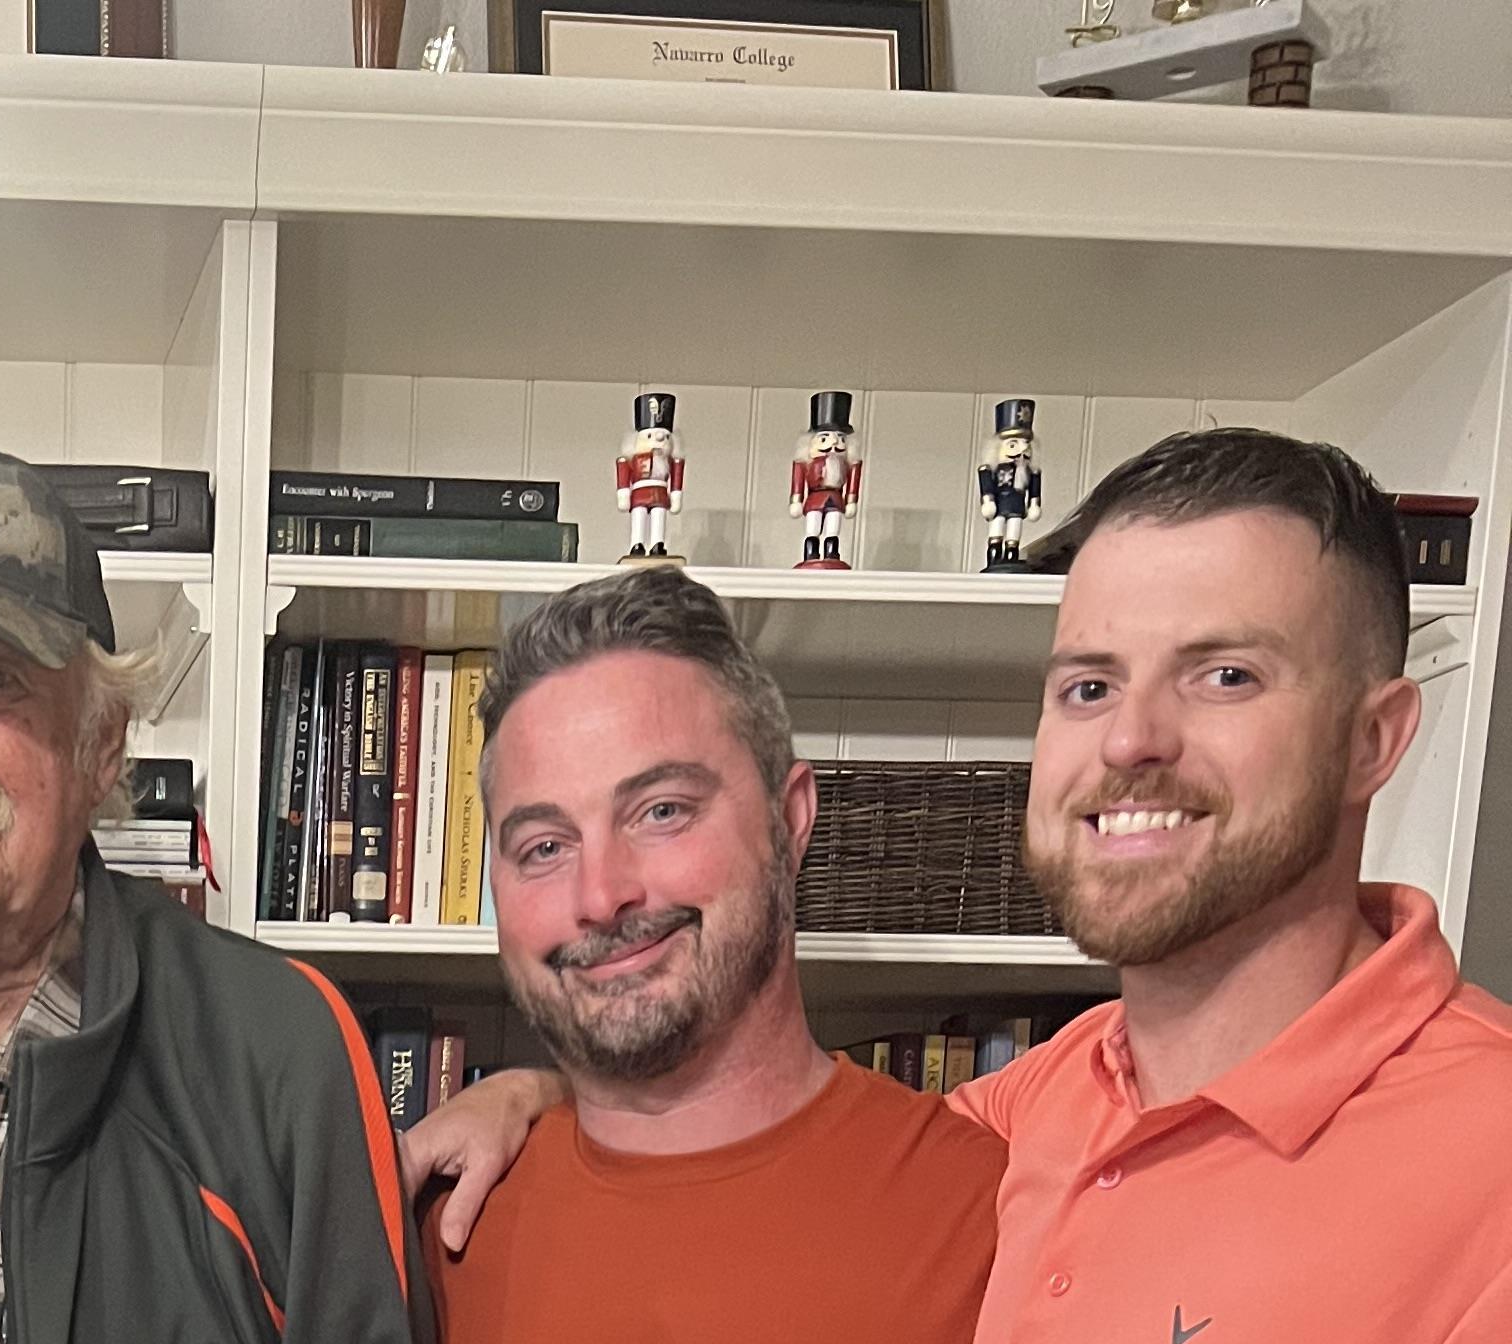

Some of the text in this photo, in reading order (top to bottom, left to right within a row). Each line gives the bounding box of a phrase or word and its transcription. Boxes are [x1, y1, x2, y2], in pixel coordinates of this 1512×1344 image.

[652, 41, 795, 72] Navarro College
[329, 485, 349, 497] with
[342, 671, 355, 710] Victory
[292, 687, 310, 794] RADICAL
[341, 724, 353, 768] Spiritual
[340, 770, 351, 812] Warfare
[285, 844, 298, 910] PLATT
